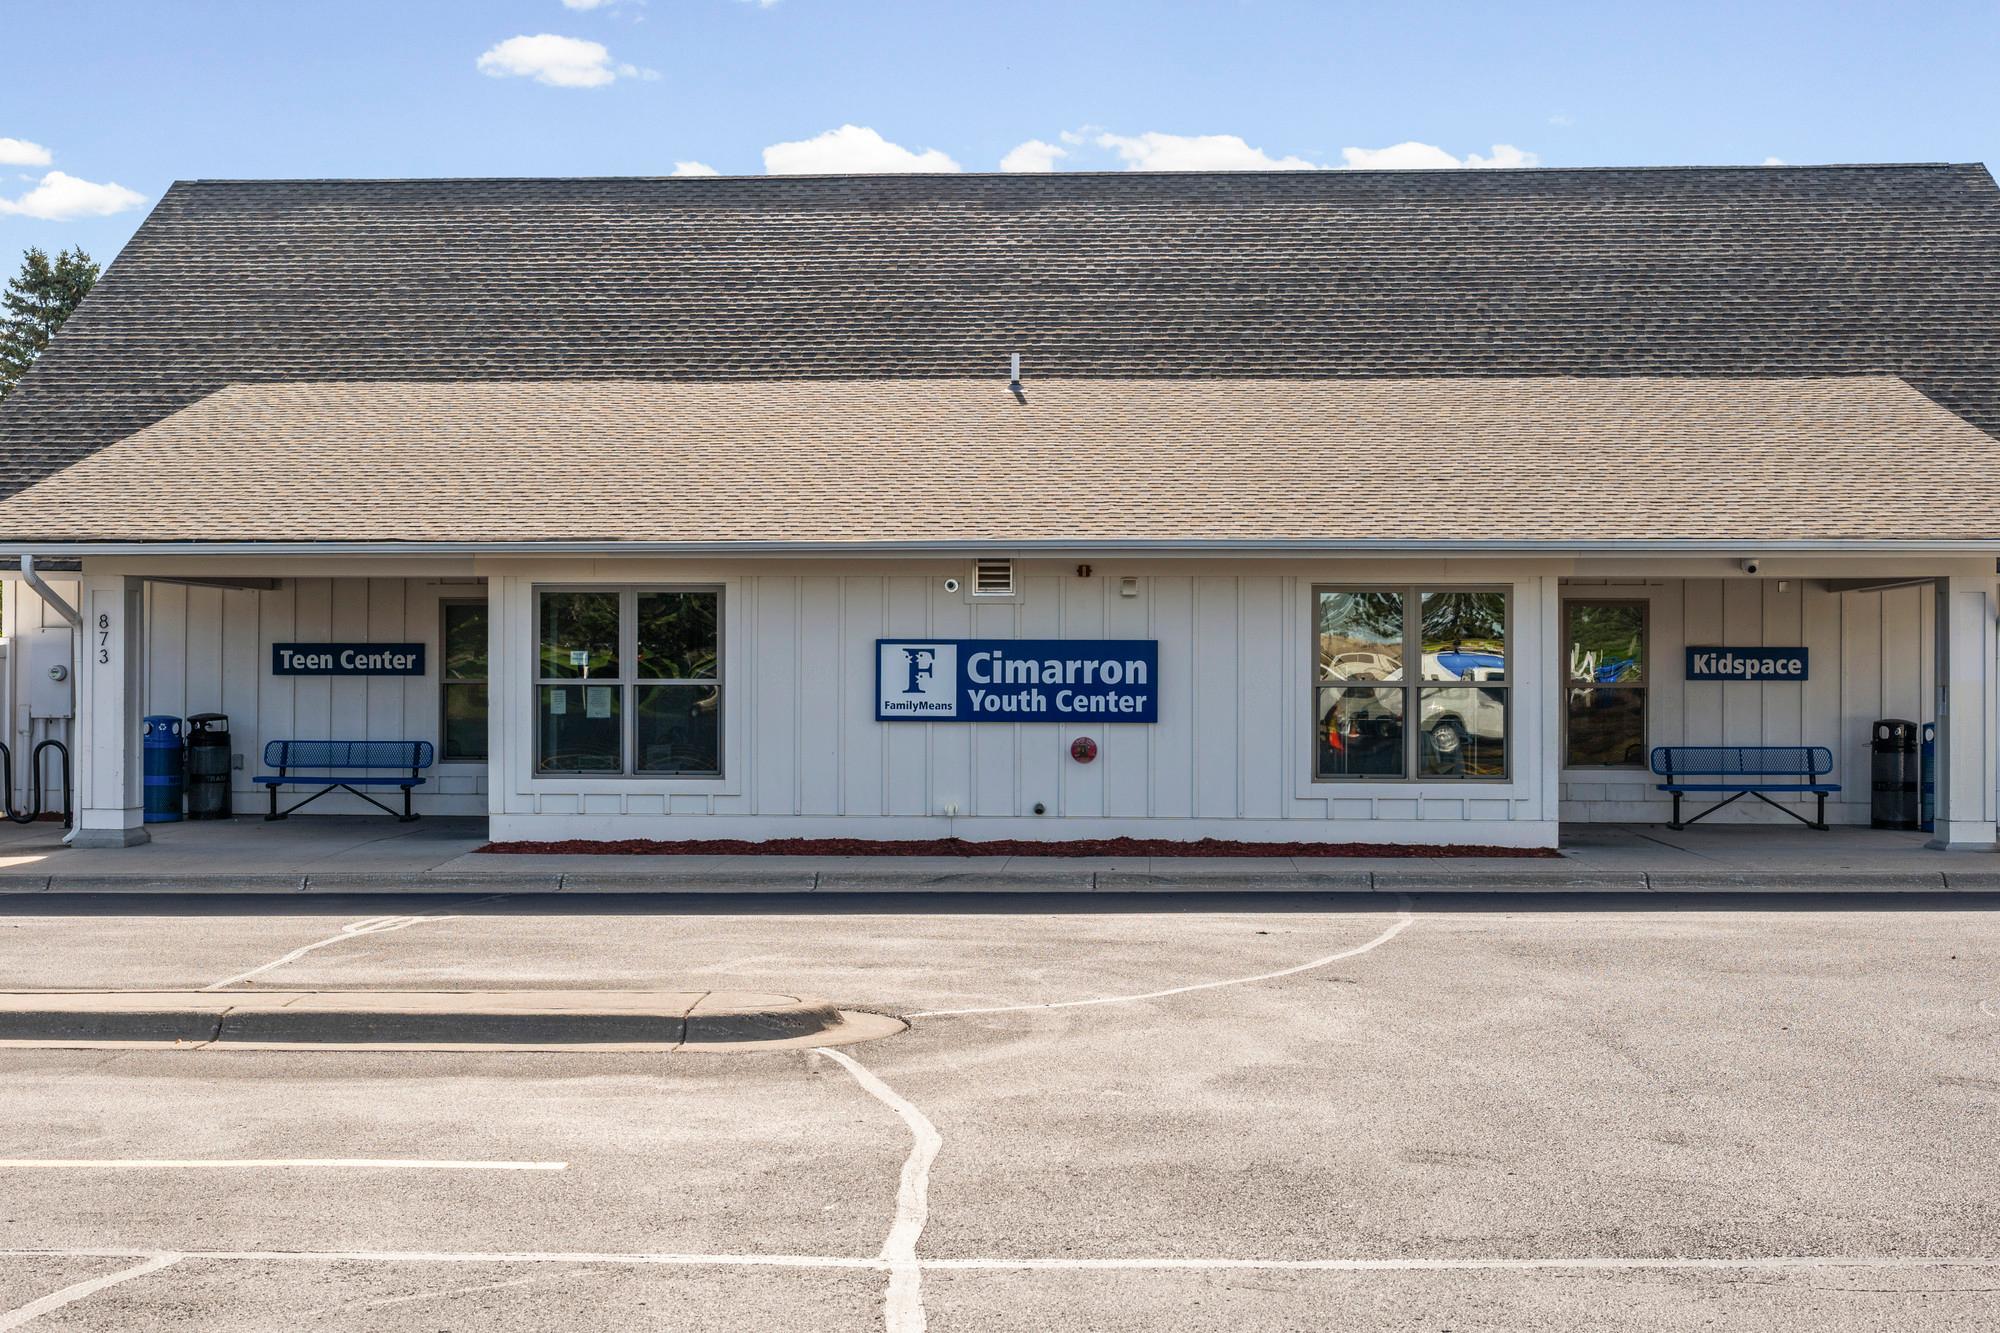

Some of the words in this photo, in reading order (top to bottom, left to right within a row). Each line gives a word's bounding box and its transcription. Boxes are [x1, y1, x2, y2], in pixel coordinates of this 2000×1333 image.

[99, 614, 109, 664] 873
[280, 650, 333, 669] Teen
[340, 649, 416, 669] Center
[967, 650, 1147, 684] Cimarron
[1694, 653, 1802, 679] Kidspace
[884, 700, 953, 713] FamilyMeans
[968, 688, 1047, 712] Youth
[1056, 689, 1147, 713] Center
